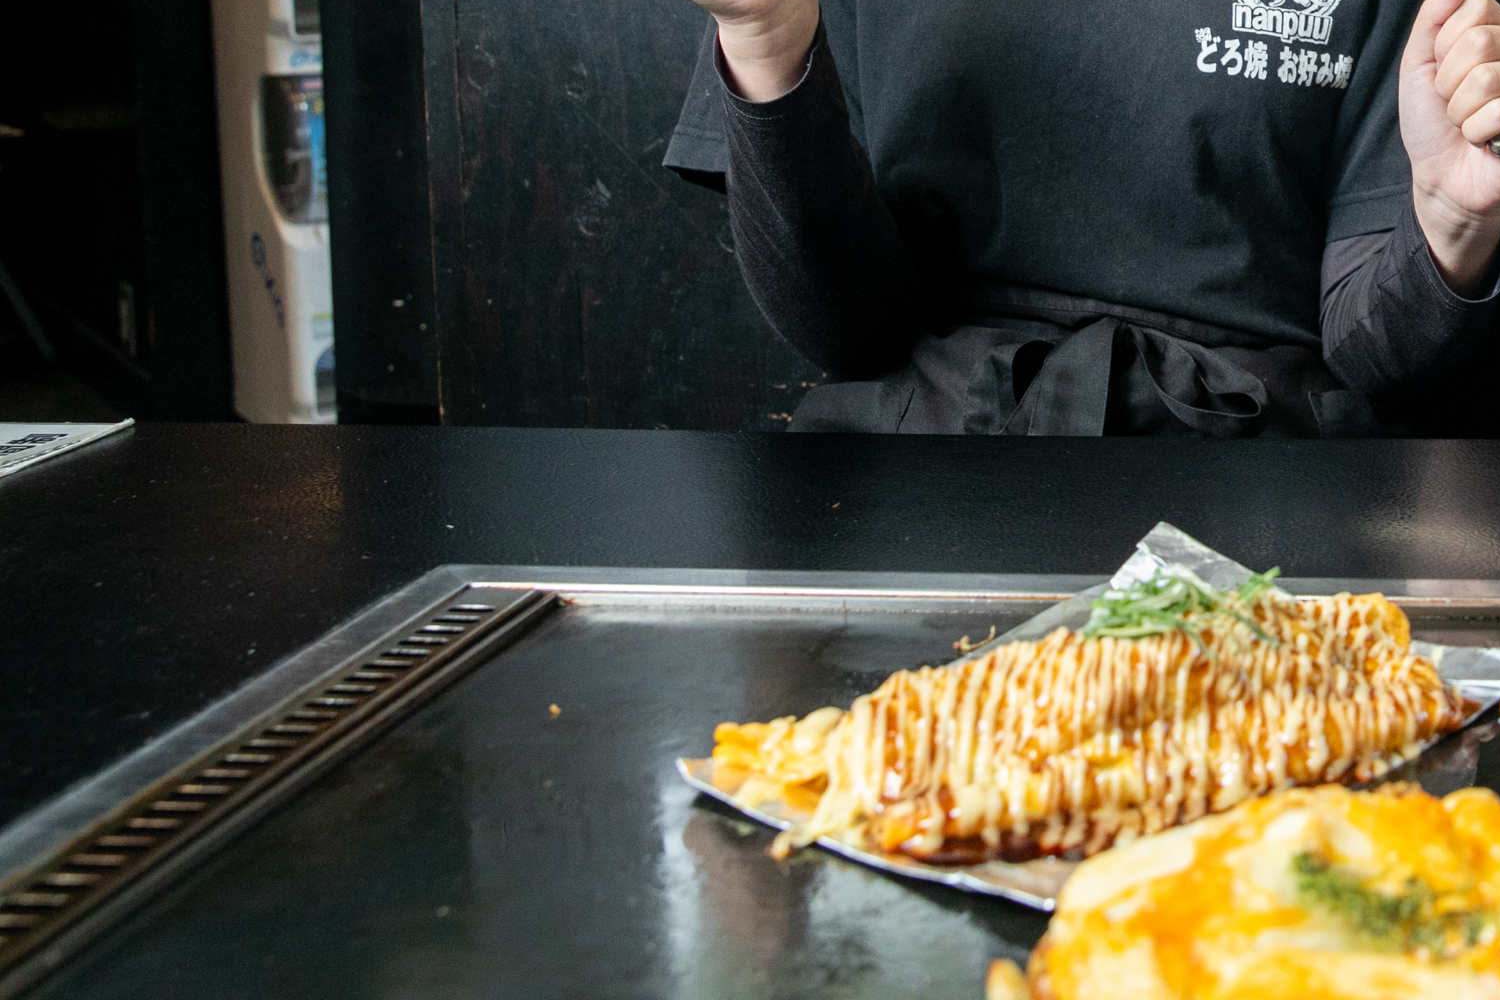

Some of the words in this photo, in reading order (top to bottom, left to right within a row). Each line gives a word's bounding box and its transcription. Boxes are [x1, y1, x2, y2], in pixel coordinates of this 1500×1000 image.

[1235, 4, 1330, 41] nanpuu
[1277, 45, 1353, 89] お好み焼
